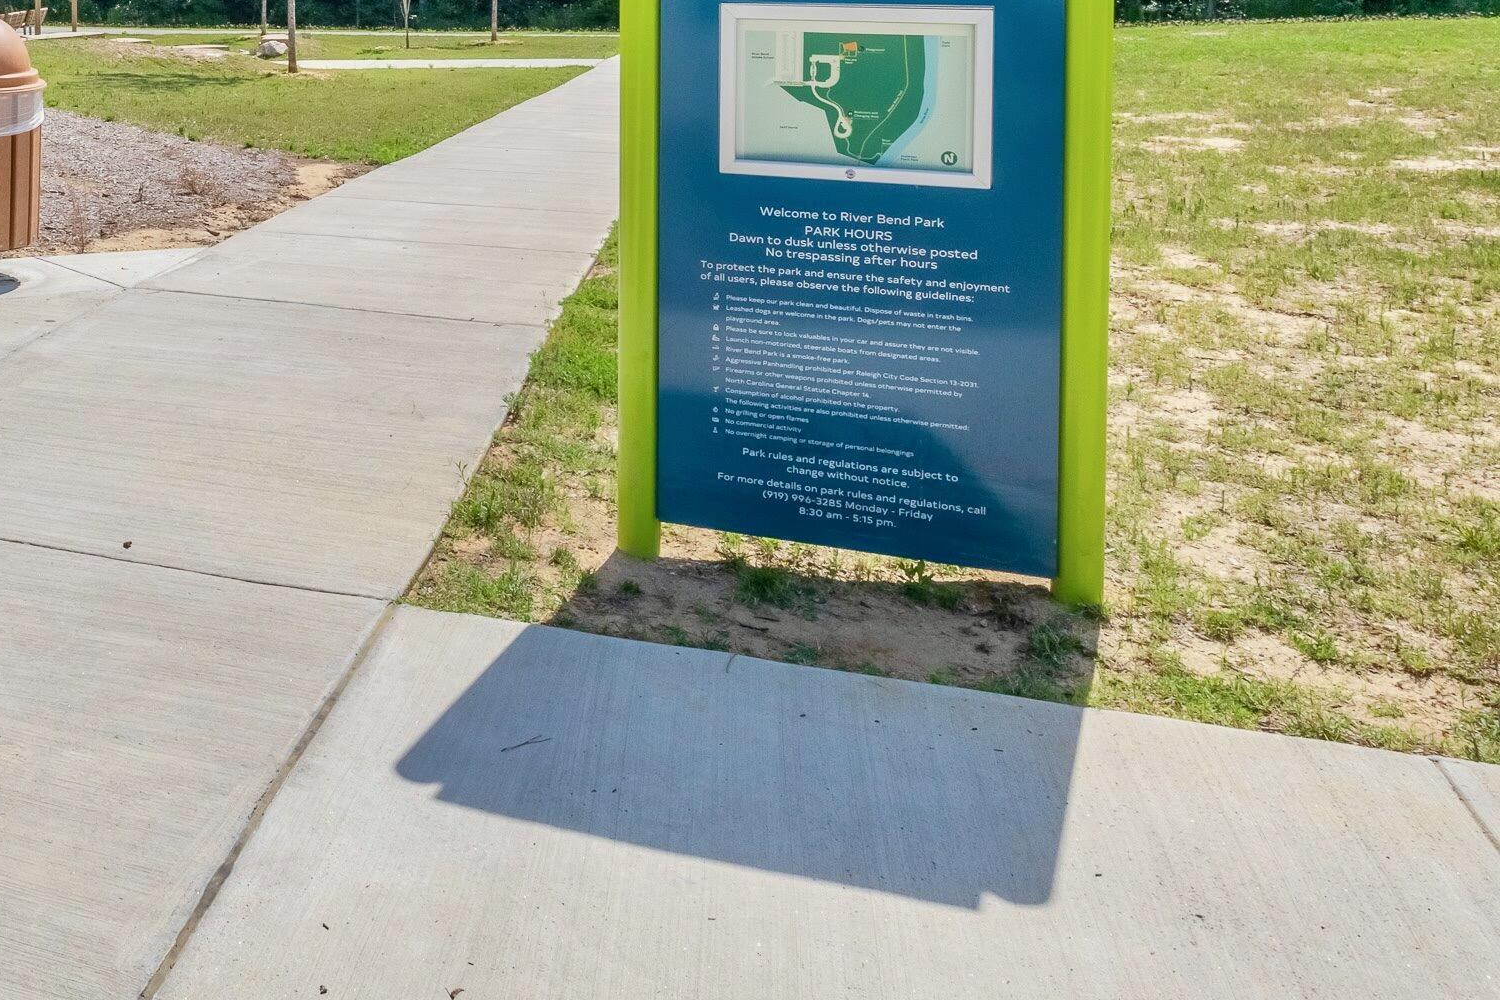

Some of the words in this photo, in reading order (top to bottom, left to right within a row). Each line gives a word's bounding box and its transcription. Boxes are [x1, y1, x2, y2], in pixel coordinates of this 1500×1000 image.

[944, 154, 954, 163] N
[759, 206, 819, 219] Welcome
[821, 211, 837, 221] to
[840, 211, 873, 223] River
[876, 214, 911, 225] Bend
[914, 216, 945, 228] Park
[804, 225, 840, 237] PARK
[844, 228, 893, 241] HOURS
[729, 232, 764, 244] Dawn
[766, 235, 782, 245] to
[784, 236, 814, 247] dusk
[817, 239, 857, 251] unless
[860, 243, 927, 256] otherwise
[930, 249, 978, 260] posted
[765, 247, 783, 257] No
[785, 249, 860, 266] trespassing
[863, 254, 897, 266] after
[900, 256, 938, 269] hours
[700, 260, 714, 269] To
[715, 263, 755, 272] protect
[757, 264, 776, 274] the
[777, 267, 802, 276] park
[804, 269, 824, 278] and
[826, 272, 863, 281] ensure
[865, 273, 885, 283] the
[886, 275, 923, 287] safety
[925, 279, 946, 288] and
[948, 281, 1010, 293] enjoyment
[700, 271, 711, 280] of
[713, 272, 725, 281] all
[727, 276, 757, 285] users,
[760, 277, 794, 287] please
[796, 280, 839, 291] observe
[841, 283, 860, 293] the
[862, 284, 913, 300] following
[914, 291, 974, 302] guidelines:
[725, 294, 748, 302] Please
[748, 296, 765, 304] keep
[864, 306, 893, 315] Dispose
[725, 305, 754, 313] Leashed
[725, 315, 763, 324] playground
[725, 325, 747, 333] Please
[798, 333, 831, 341] valuables
[908, 343, 926, 351] they
[725, 345, 742, 353] River
[743, 347, 762, 355] Bend
[762, 349, 778, 357] Park
[791, 354, 831, 362] smoke-free
[803, 344, 837, 352] steerable
[859, 348, 877, 356] from
[877, 351, 918, 360] designated
[725, 388, 770, 397] Consumption
[770, 390, 779, 398] of
[805, 395, 842, 405] prohibited
[841, 398, 852, 406] on
[742, 447, 766, 458] Park
[768, 451, 793, 461] rules
[795, 456, 816, 464] and
[818, 458, 878, 472] regulations
[880, 466, 899, 475] are
[901, 468, 943, 480] subject
[945, 473, 959, 482] to
[786, 465, 824, 479] change
[826, 471, 869, 483] without
[872, 477, 910, 488] notice.
[717, 471, 735, 481] For
[737, 476, 764, 485] more
[766, 478, 802, 491] details
[804, 485, 818, 493] on
[820, 487, 844, 496] park
[846, 490, 873, 500] rules
[875, 494, 896, 503] and
[898, 498, 964, 513] regulations,
[967, 506, 986, 515] call
[762, 490, 789, 501] (919)
[791, 493, 842, 508] 996-3285
[844, 501, 888, 515] Monday
[898, 508, 933, 521] Friday
[798, 506, 823, 517] 8:30
[825, 511, 843, 520] am
[852, 513, 873, 524] 5:15
[875, 519, 896, 527] pm.
